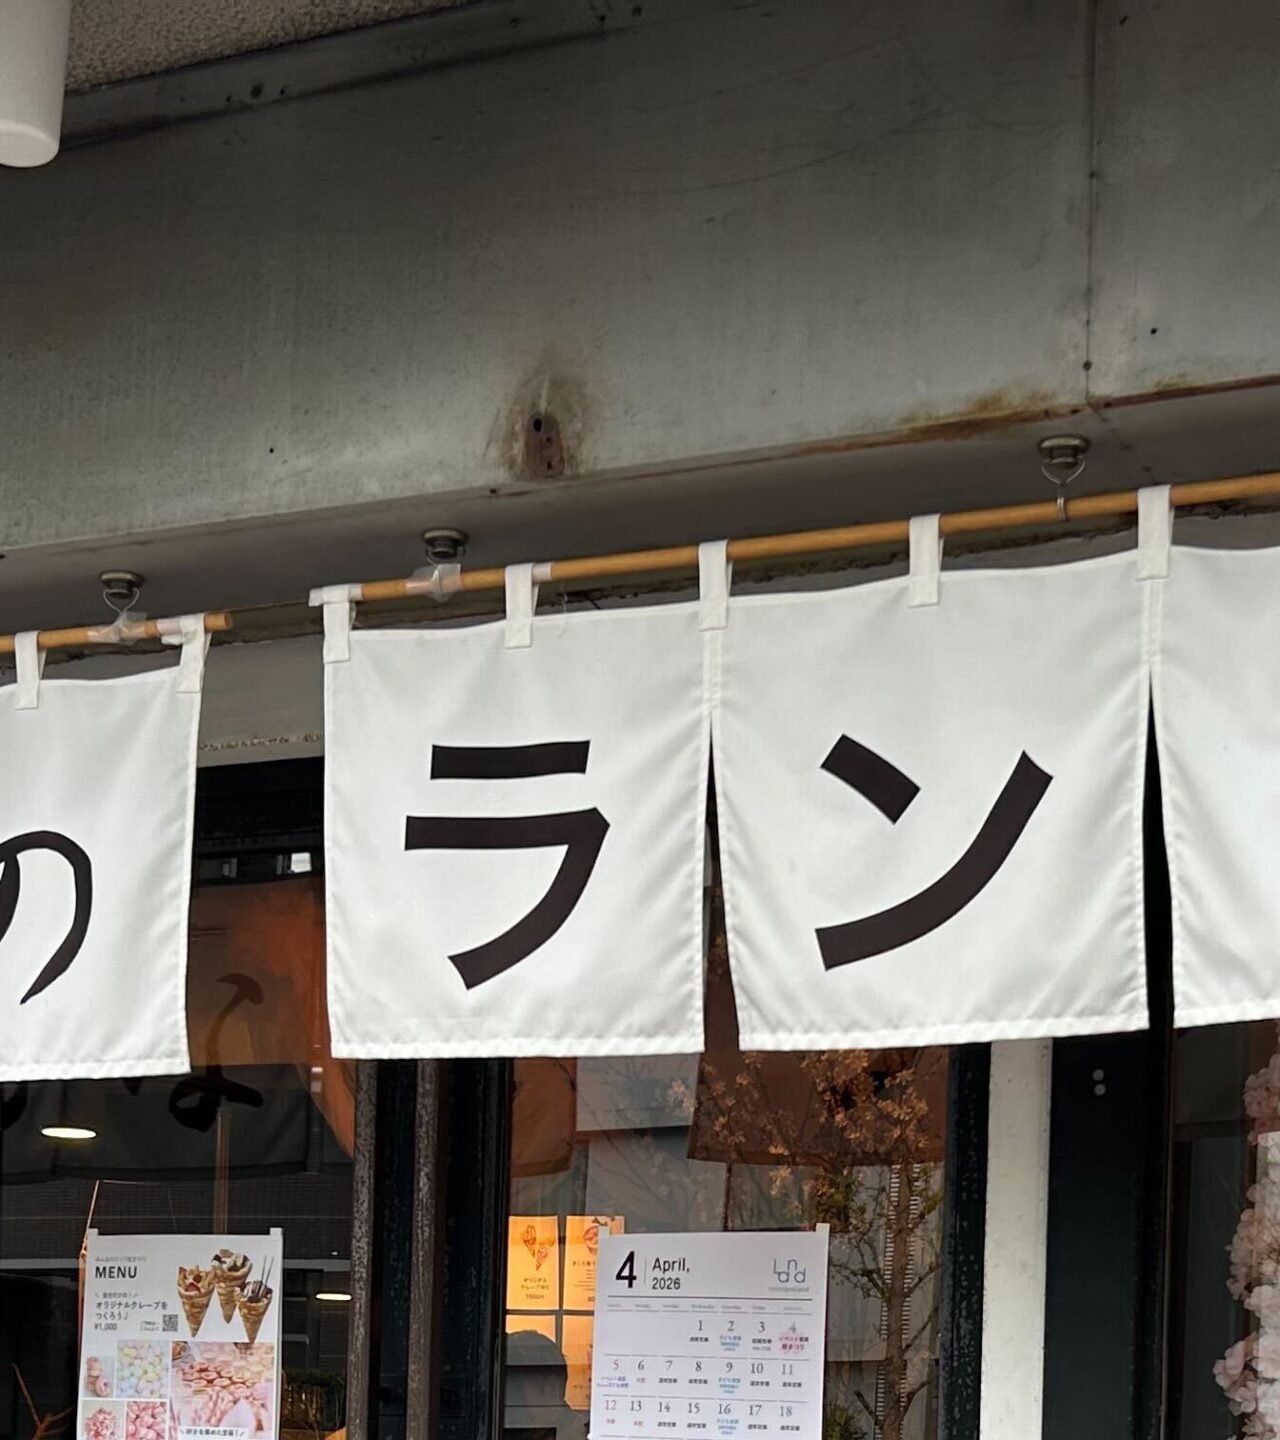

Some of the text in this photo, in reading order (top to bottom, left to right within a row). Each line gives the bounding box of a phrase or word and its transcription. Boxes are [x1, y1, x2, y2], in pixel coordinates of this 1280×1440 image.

[95, 1265, 138, 1279] MENU
[615, 1250, 637, 1289] 4
[651, 1256, 691, 1273] April,
[651, 1276, 681, 1291] 2026
[727, 1320, 735, 1332] 2
[758, 1321, 766, 1333] 3
[637, 1359, 645, 1371] 6
[665, 1360, 673, 1371] 7
[694, 1361, 703, 1372] 8
[725, 1361, 733, 1374] 9
[750, 1363, 764, 1375] 10
[781, 1363, 794, 1375] 11
[605, 1400, 793, 1418] 12 13 14 15 16 17 18
